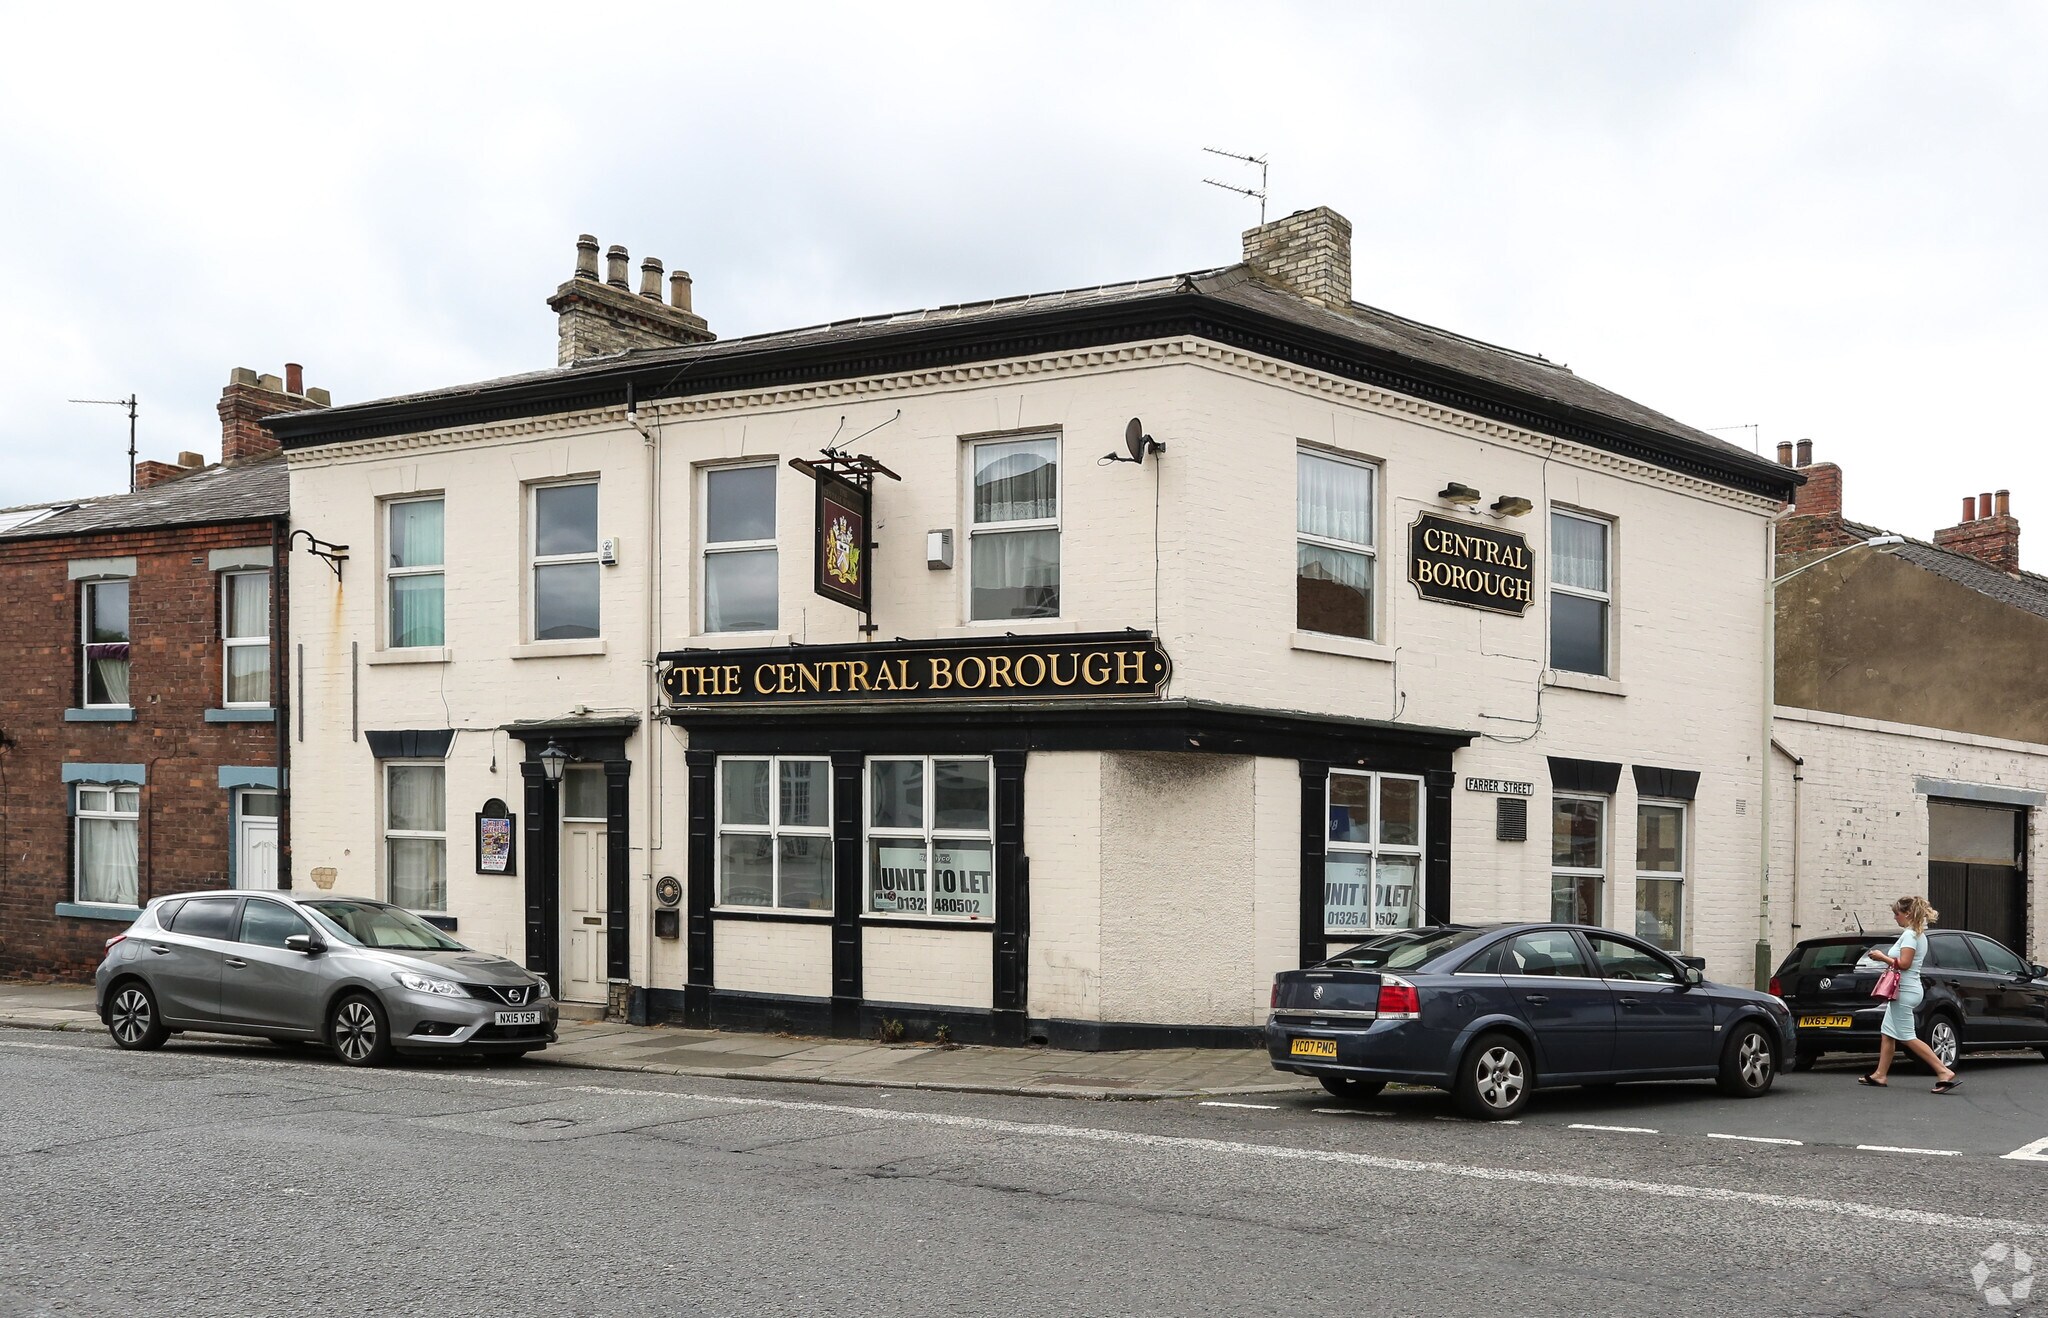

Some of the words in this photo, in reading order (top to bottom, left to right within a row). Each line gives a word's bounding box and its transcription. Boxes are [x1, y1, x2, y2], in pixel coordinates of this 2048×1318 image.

[1423, 528, 1527, 570] CENTRAL
[1417, 558, 1531, 602] BOROUGH
[673, 665, 742, 695] THE
[753, 660, 919, 694] CENTRAL
[928, 651, 1148, 689] BOROUGH
[1469, 778, 1499, 791] FARRER
[1503, 781, 1531, 794] STREET
[881, 868, 927, 891] UNIT
[960, 870, 991, 894] LET
[1385, 885, 1412, 907] LET
[935, 898, 980, 913] 480502
[1328, 911, 1358, 925] 01325
[500, 1013, 519, 1024] NX15
[521, 1012, 536, 1023] YSR
[1803, 1017, 1827, 1026] NX63
[1829, 1016, 1848, 1025] JYP
[1295, 1040, 1315, 1052] YC07
[1316, 1041, 1334, 1054] PMO
